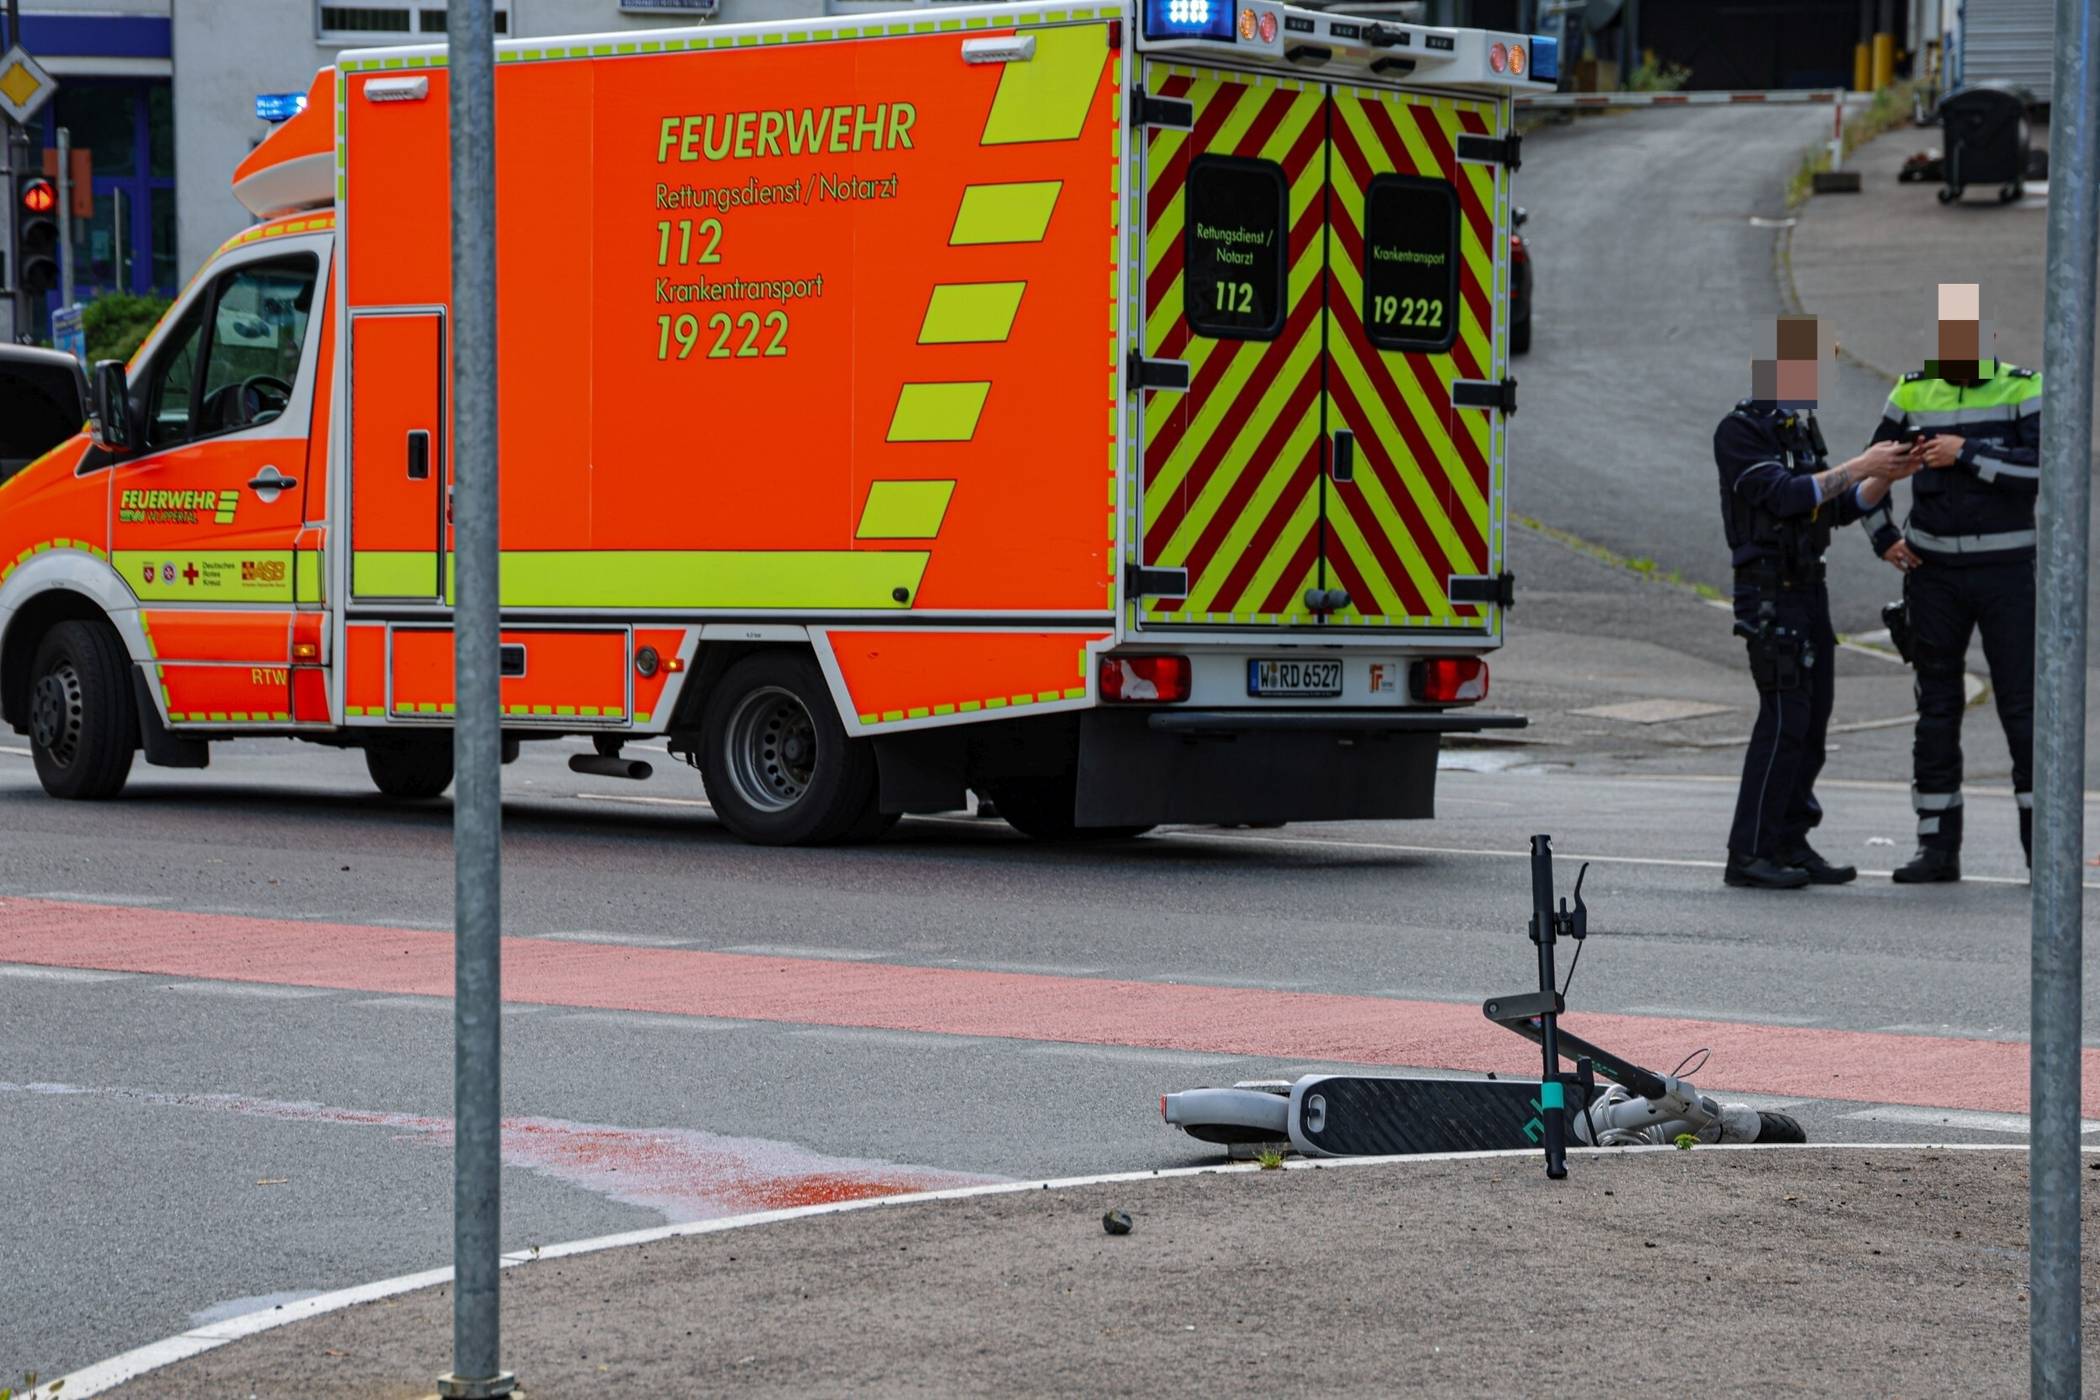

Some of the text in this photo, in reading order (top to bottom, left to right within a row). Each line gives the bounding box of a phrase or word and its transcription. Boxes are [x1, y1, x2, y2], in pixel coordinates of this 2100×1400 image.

[657, 101, 917, 163] FEUERWEHR
[656, 177, 802, 213] Rettungsdienst
[819, 172, 898, 201] Notarzt
[657, 217, 723, 266] 112
[1196, 222, 1265, 245] Rettungsdienst
[1216, 247, 1254, 265] Notarzt
[1374, 245, 1445, 268] Krankentransport
[655, 273, 823, 305] Krankentransport
[1216, 281, 1254, 313] 112
[657, 309, 789, 360] 19 222
[120, 490, 216, 509] FEUERWEHR
[251, 667, 288, 686] RTW
[1303, 664, 1339, 688] 6527
